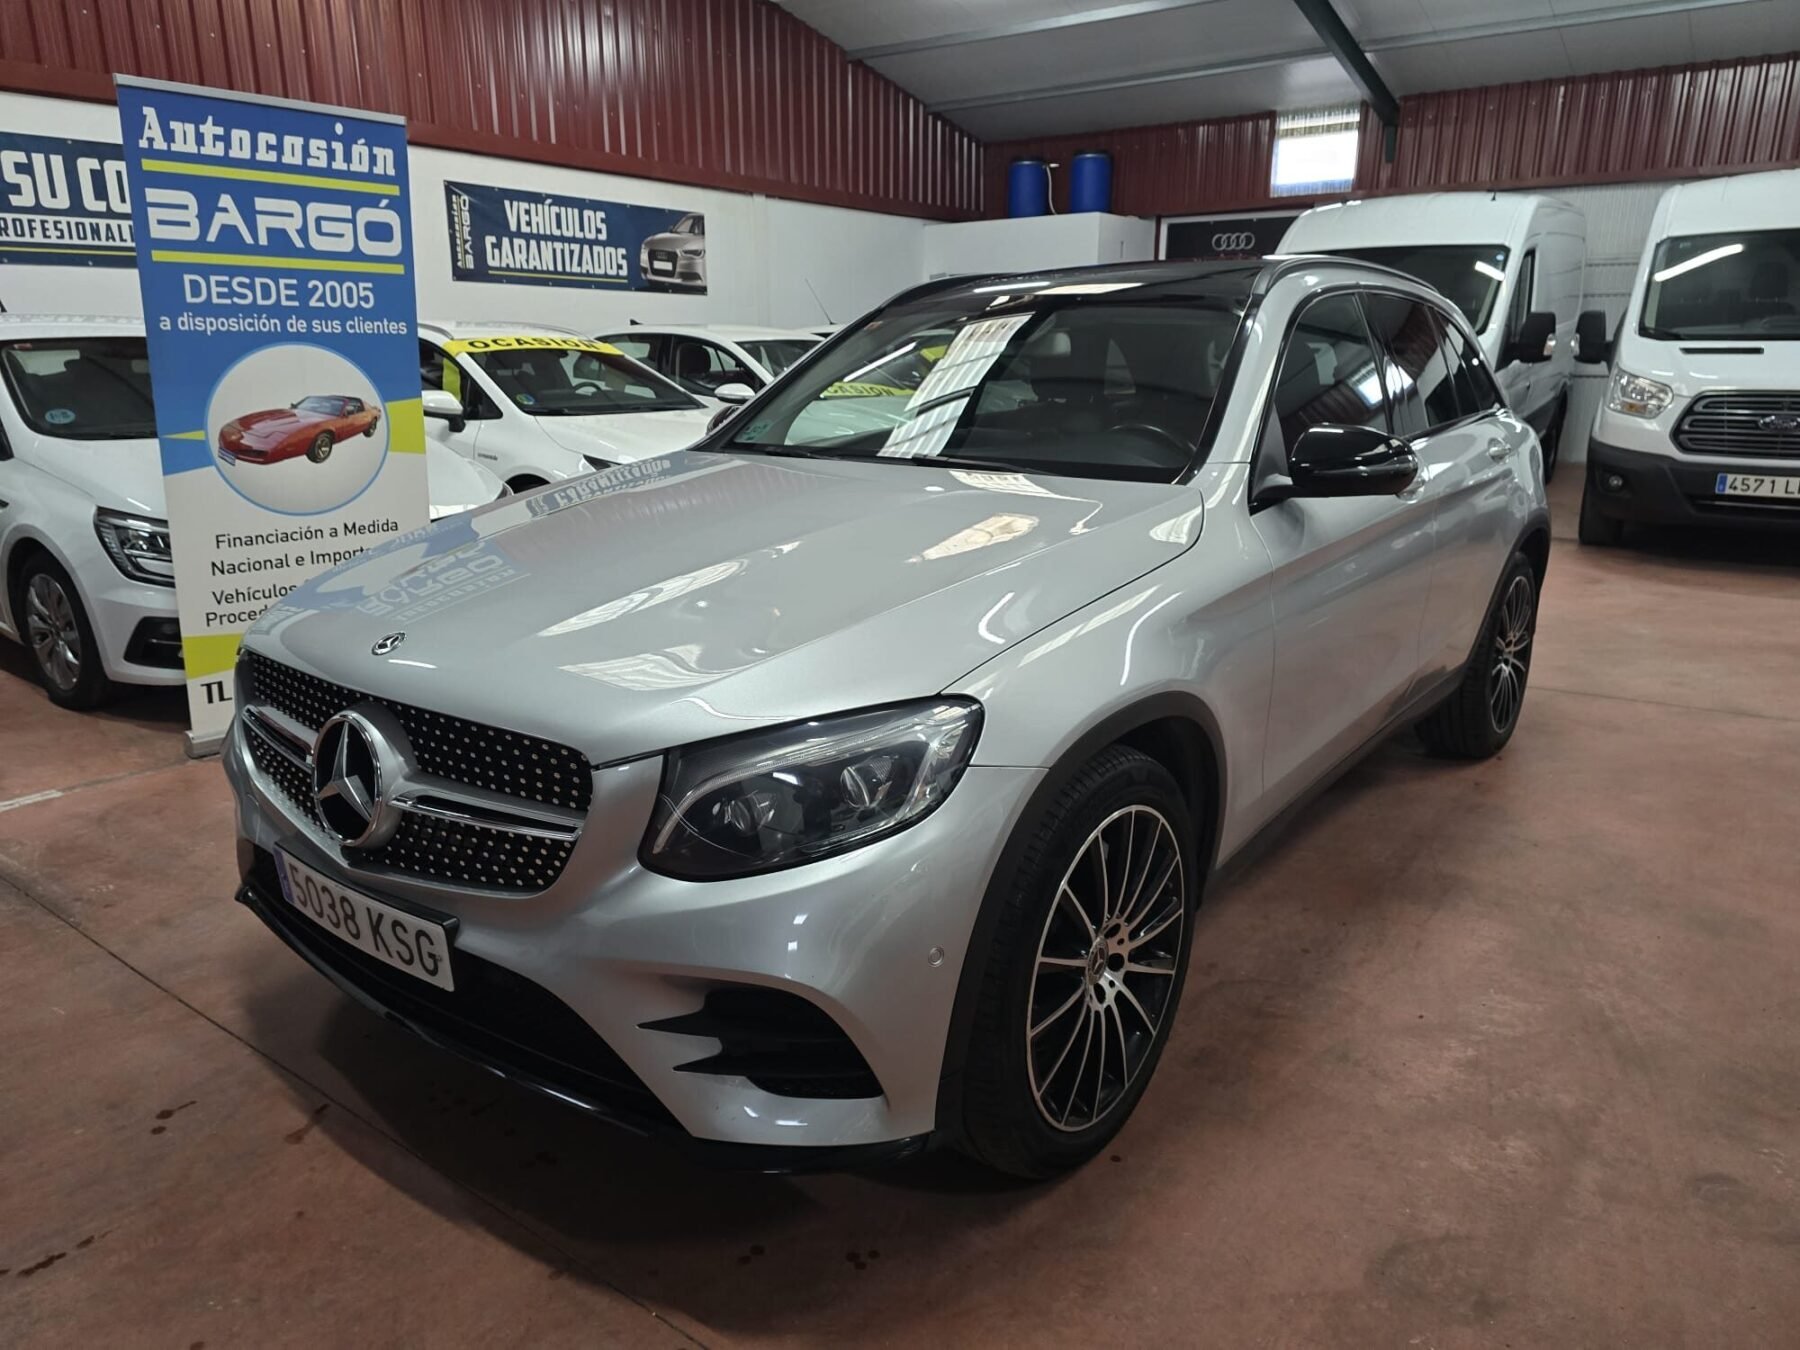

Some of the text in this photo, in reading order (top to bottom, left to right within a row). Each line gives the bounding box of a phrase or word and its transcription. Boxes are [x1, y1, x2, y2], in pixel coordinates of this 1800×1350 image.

[139, 106, 396, 176] Autocasión
[0, 150, 132, 214] SU CO
[144, 187, 402, 257] BARGÓ
[504, 198, 607, 241] VEHÍCULOS
[485, 236, 628, 277] GARANTIZADOS
[183, 273, 374, 309] DESDE 2005
[159, 312, 408, 337] a disposición de sus clientes
[1729, 477, 1776, 494] 4571
[215, 525, 324, 549] Financiación
[329, 528, 338, 538] a
[344, 518, 399, 537] Medida
[211, 553, 290, 576] Nacional
[295, 556, 305, 567] e
[310, 546, 371, 566] Import
[200, 680, 233, 704] TL
[288, 863, 441, 977] 5038 KSG
